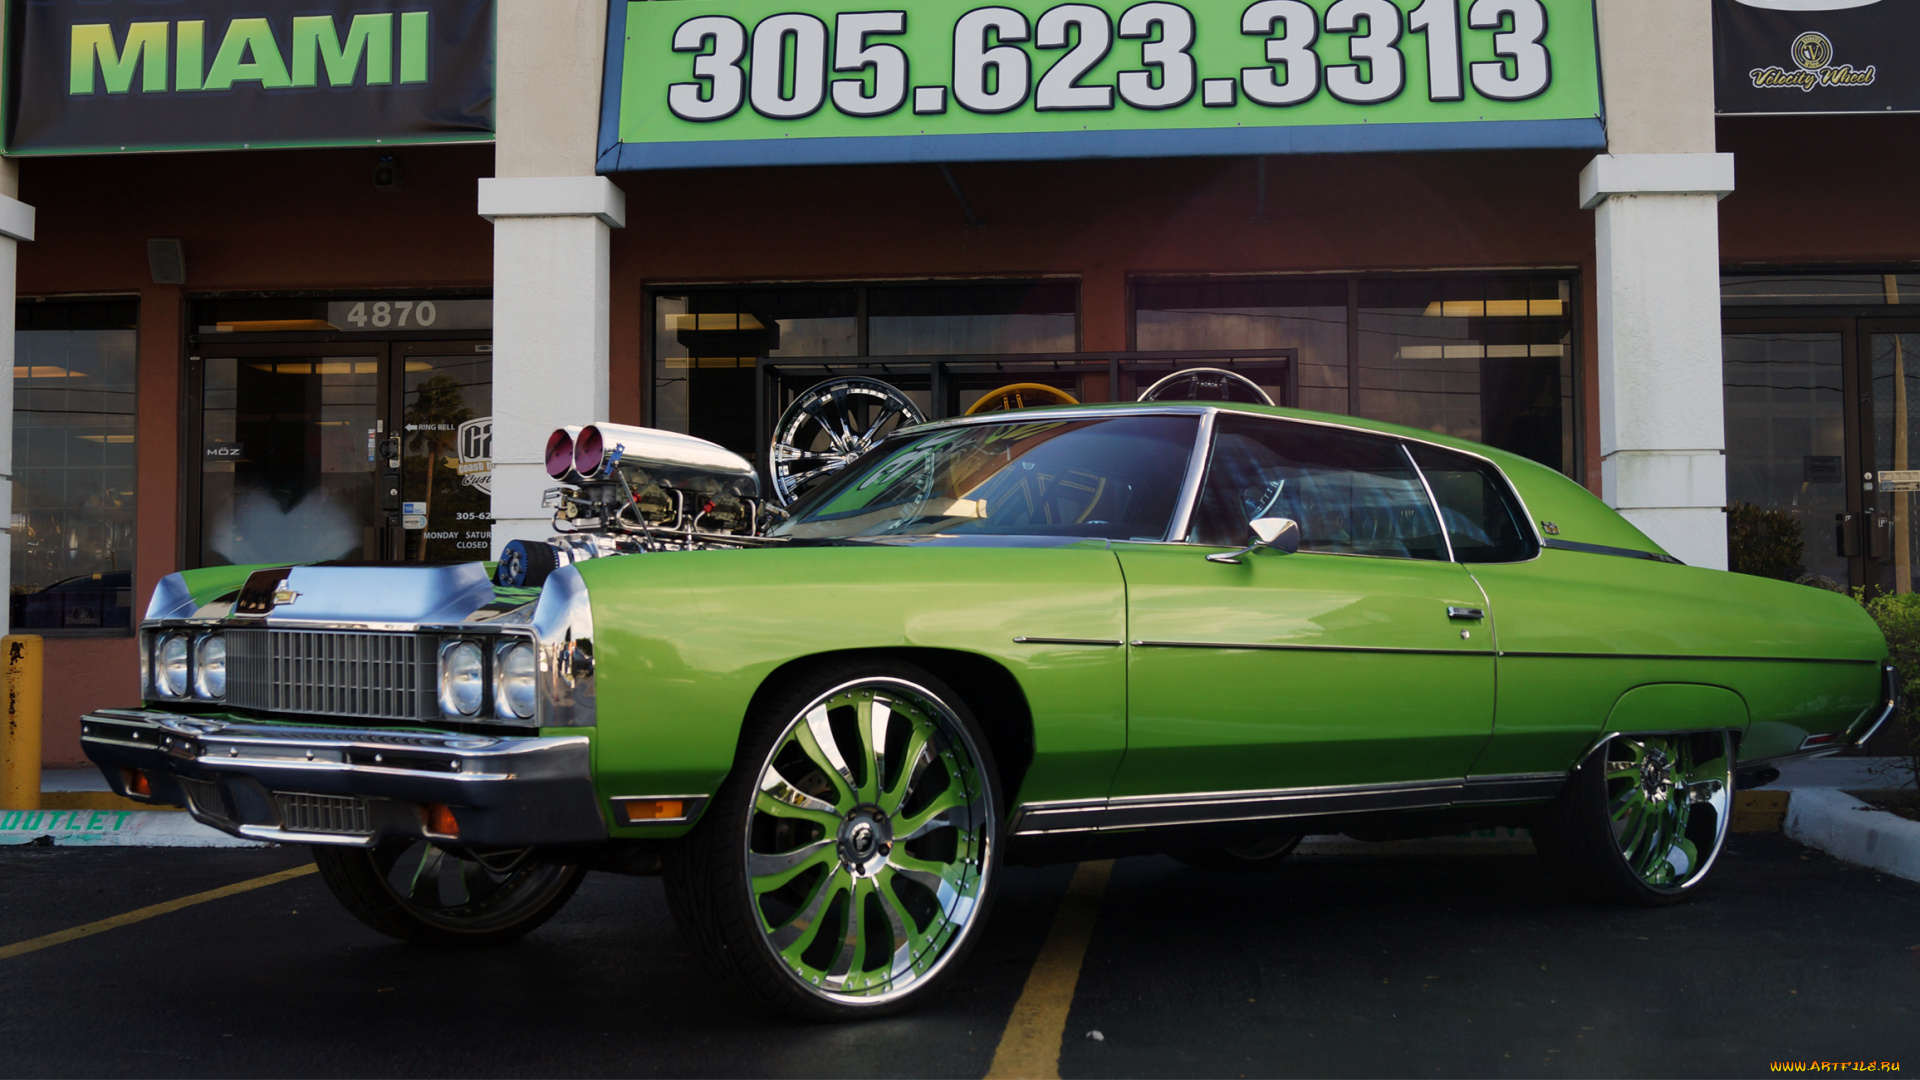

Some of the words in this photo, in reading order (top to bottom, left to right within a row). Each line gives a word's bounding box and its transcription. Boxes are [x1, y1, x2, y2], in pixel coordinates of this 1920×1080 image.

[69, 11, 430, 96] MIAMI
[667, 0, 1552, 121] 305.623.3313
[1752, 67, 1817, 90] Velocity
[1819, 66, 1873, 84] Wheel
[347, 301, 436, 328] 4870
[418, 423, 436, 431] RING
[437, 423, 456, 431] BELL
[423, 531, 459, 539] MONDAY
[456, 541, 488, 549] CLOSED
[0, 810, 133, 831] OUTLET
